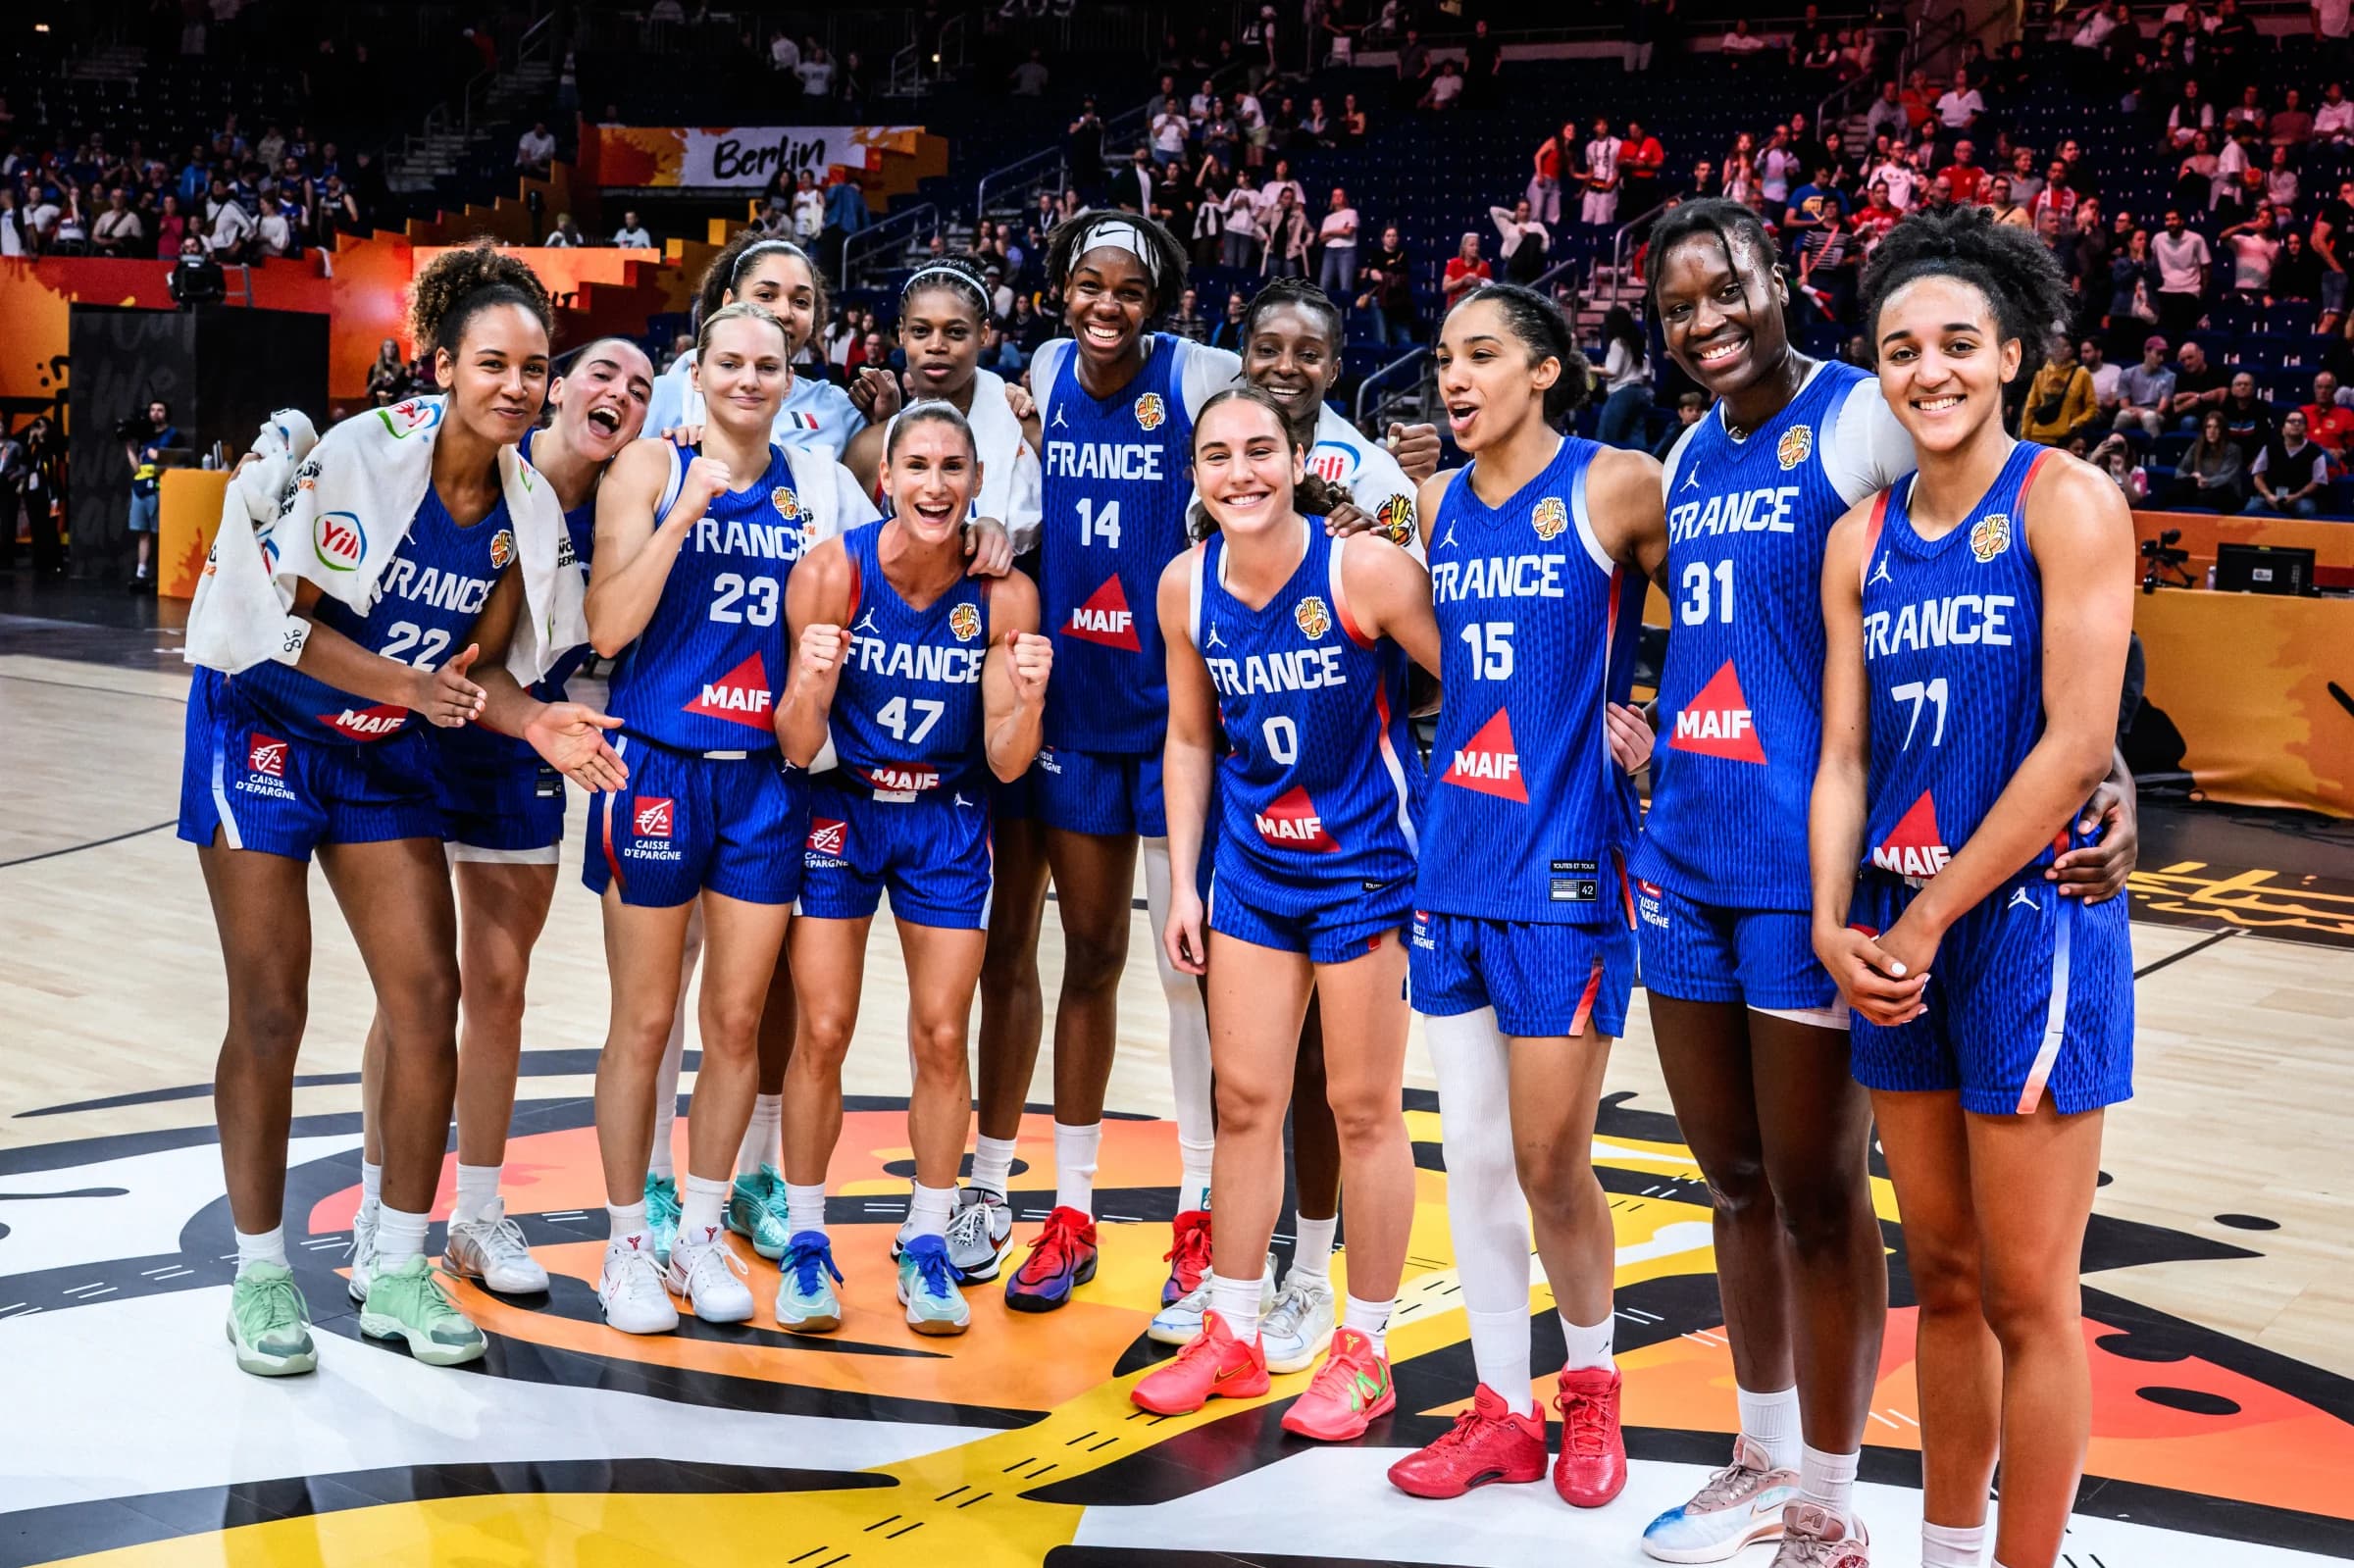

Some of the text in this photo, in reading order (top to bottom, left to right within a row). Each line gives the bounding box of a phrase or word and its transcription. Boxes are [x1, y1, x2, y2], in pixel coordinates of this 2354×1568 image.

[713, 135, 825, 179] Berlin
[1047, 440, 1164, 481] FRANCE
[1312, 456, 1344, 481] ili
[1075, 497, 1121, 549] 14
[1668, 486, 1800, 550] FRANCE
[679, 518, 806, 561] RANC
[709, 573, 780, 627] 23
[1431, 554, 1565, 608] FRANCE
[1681, 559, 1734, 627] 31
[1072, 608, 1133, 633] MAIF
[379, 621, 450, 673] 22
[844, 635, 987, 683] FRANCE
[1460, 622, 1513, 682] 15
[1205, 645, 1347, 695] FRANCE
[701, 683, 772, 713] MAIF
[1891, 678, 1949, 752] 71
[335, 709, 407, 734] MAIF
[877, 696, 945, 744] 47
[1262, 716, 1298, 765] 0
[1676, 709, 1753, 739] MAIF
[250, 775, 284, 788] CAISSE
[871, 769, 940, 789] MAIF
[1455, 750, 1519, 781] MAIF
[235, 781, 296, 800] D'EPARGNE
[636, 839, 670, 850] CAISSE
[1255, 814, 1321, 840] MAIF
[624, 848, 682, 860] D'EPARGNE
[1873, 845, 1951, 876] MAIF
[1581, 885, 1594, 895] 42
